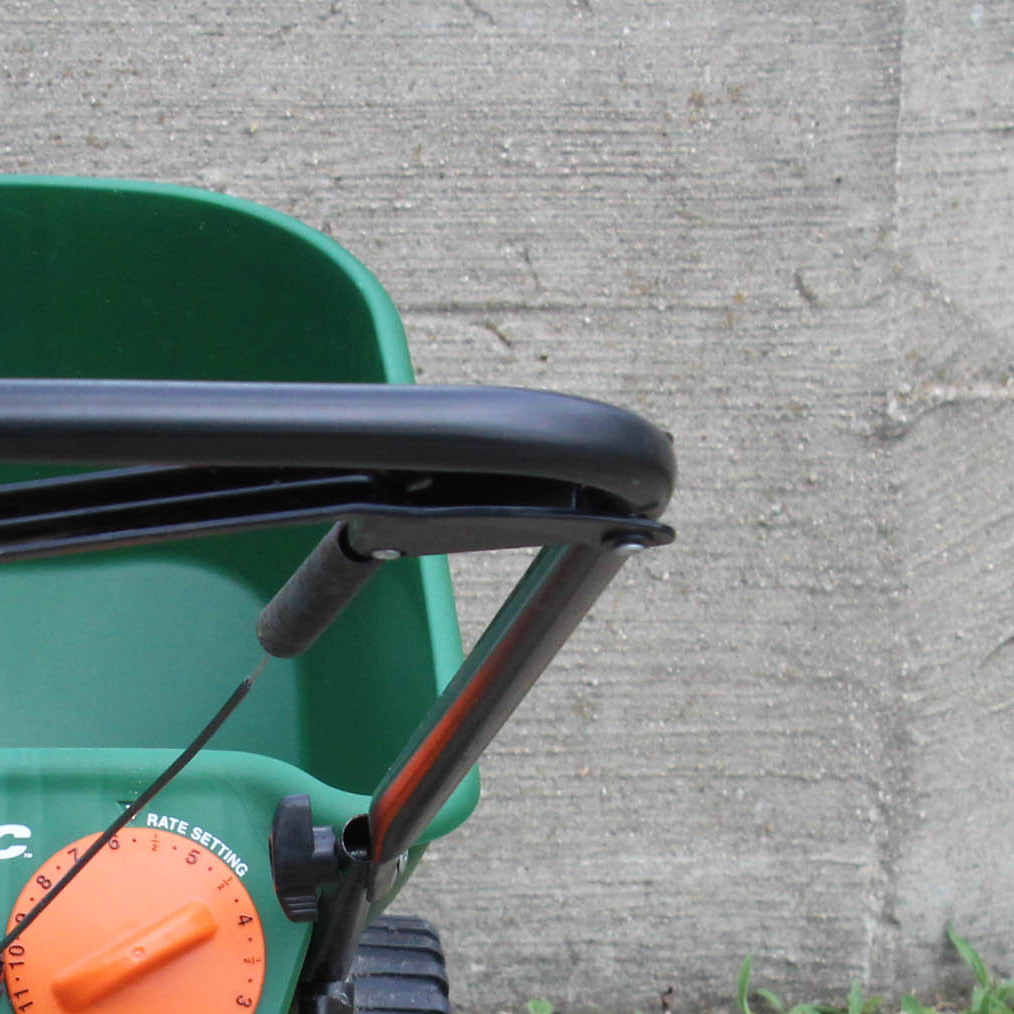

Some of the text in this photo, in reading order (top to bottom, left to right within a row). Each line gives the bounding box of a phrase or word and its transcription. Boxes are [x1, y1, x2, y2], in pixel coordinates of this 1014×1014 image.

[108, 834, 120, 850] 6
[147, 813, 249, 878] RATE SETTING
[67, 847, 80, 864] 7
[185, 849, 201, 865] 5
[36, 875, 52, 890] 8
[238, 914, 253, 926] 4
[8, 945, 25, 970] 10
[14, 988, 34, 1013] 11
[235, 995, 253, 1008] 3
